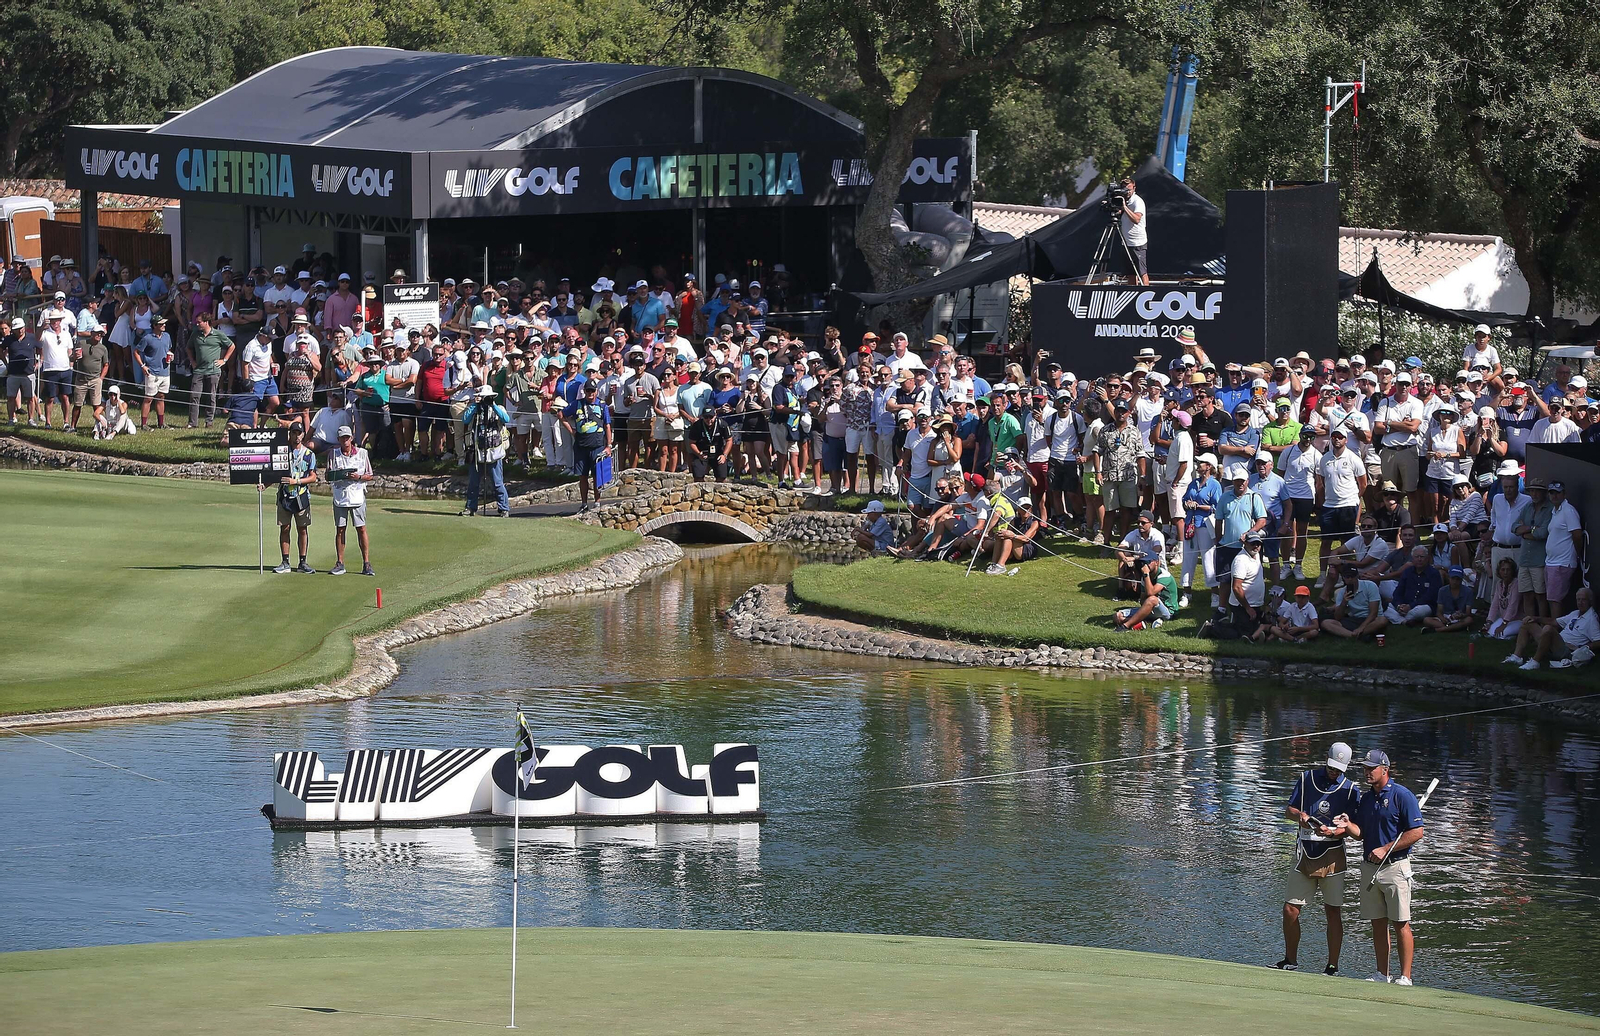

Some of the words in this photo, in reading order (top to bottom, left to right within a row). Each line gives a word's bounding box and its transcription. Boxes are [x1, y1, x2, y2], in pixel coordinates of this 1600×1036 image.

[81, 148, 117, 176] LIV
[115, 153, 159, 181] GOLF
[176, 148, 295, 198] CAFETERIA
[311, 164, 349, 193] LIV
[347, 168, 394, 197] GOLF
[608, 152, 804, 201] CAFETERIA
[901, 156, 958, 185] OLF
[444, 168, 507, 198] LIV
[504, 166, 580, 195] GOLF
[409, 287, 429, 296] GOLF
[1067, 290, 1139, 319] LIV
[1135, 290, 1223, 321] GOLF
[1094, 322, 1159, 338] ANDALUCÍA
[256, 432, 277, 440] GOLF
[277, 748, 492, 803] LIV
[492, 745, 759, 800] GOLF
